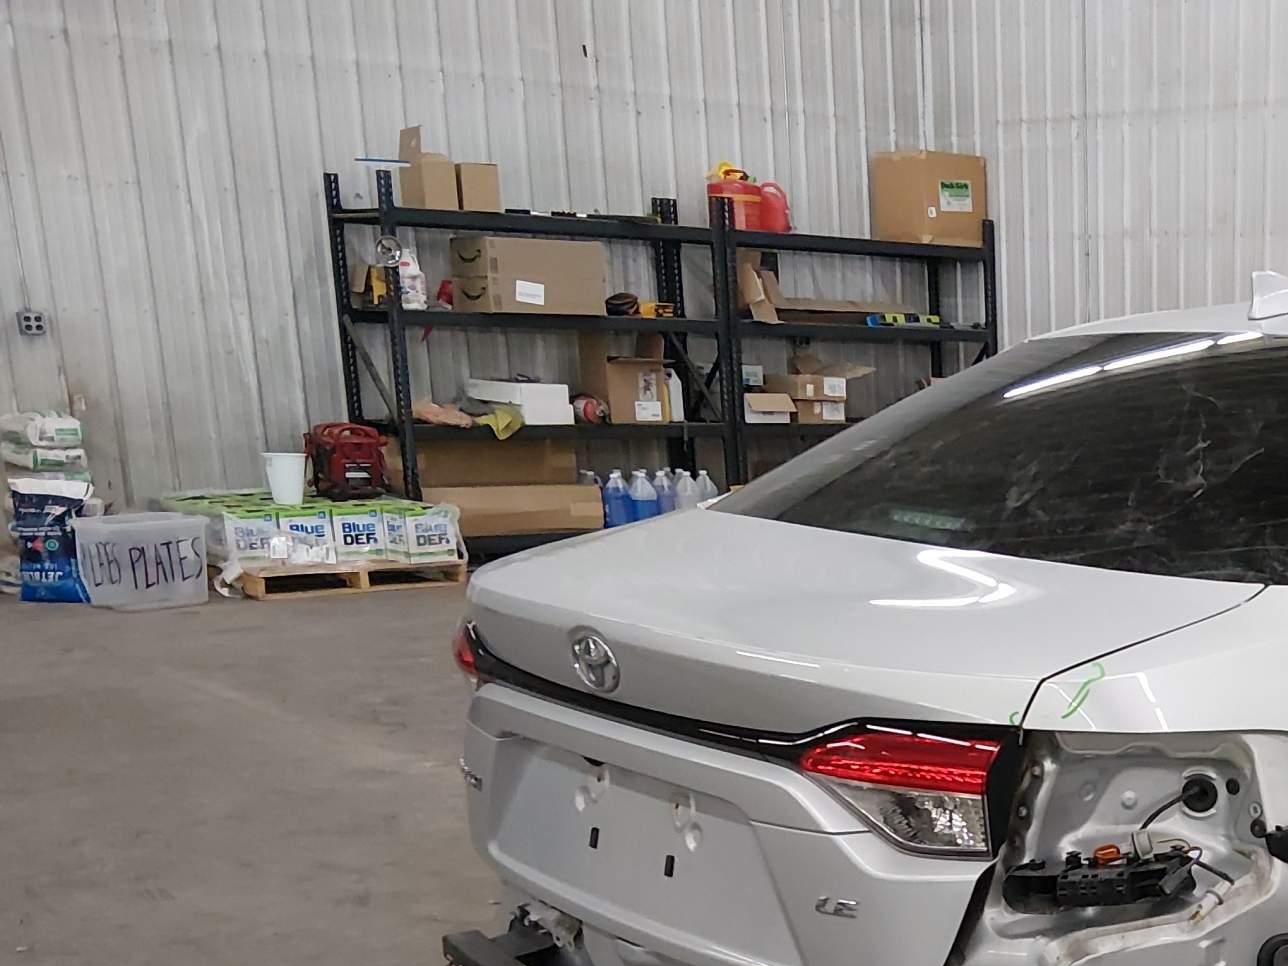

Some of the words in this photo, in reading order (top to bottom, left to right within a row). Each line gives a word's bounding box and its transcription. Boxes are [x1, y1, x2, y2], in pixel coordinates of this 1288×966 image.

[342, 523, 376, 533] Blue
[128, 537, 203, 590] PLATES
[814, 896, 858, 919] LE
